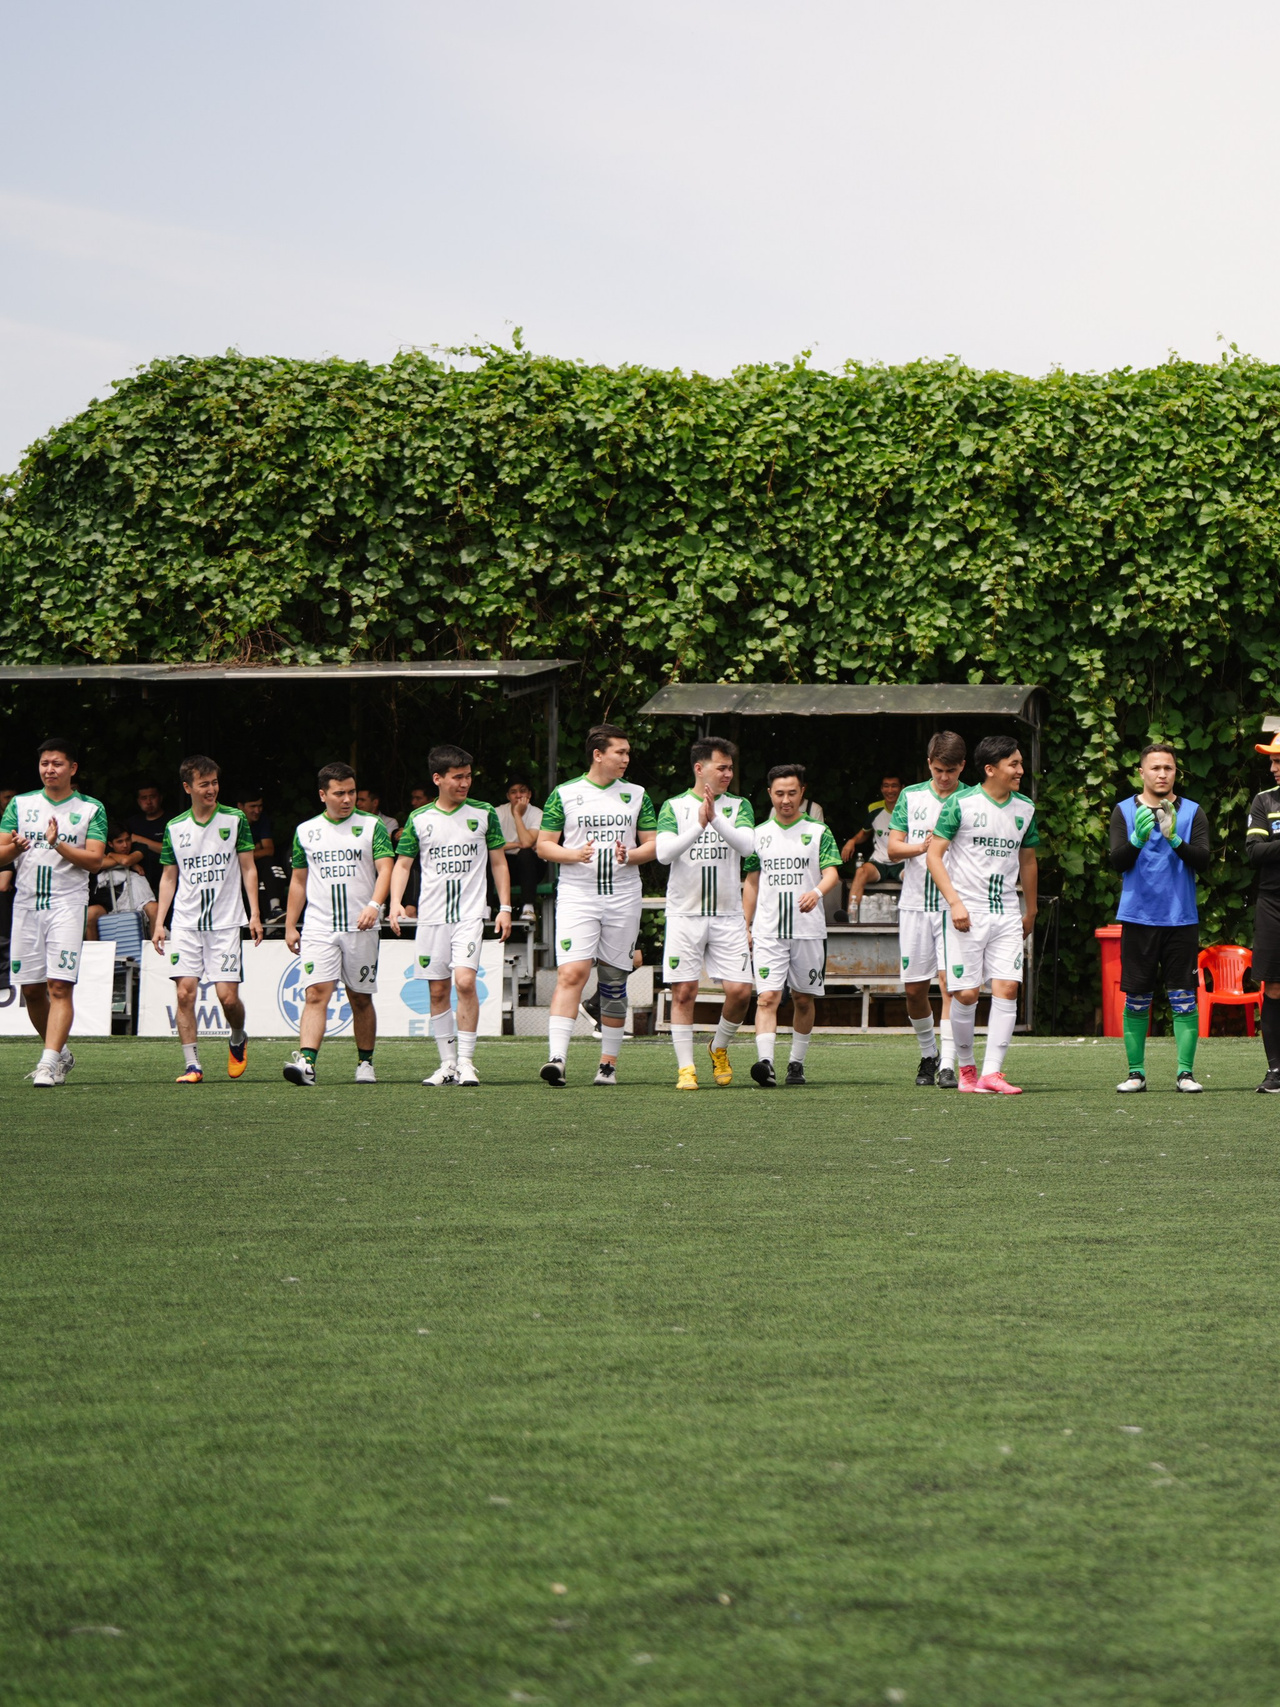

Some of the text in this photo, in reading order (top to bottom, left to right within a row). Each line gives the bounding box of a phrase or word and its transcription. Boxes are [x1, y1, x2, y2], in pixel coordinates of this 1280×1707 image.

[25, 809, 39, 822] 55
[577, 814, 632, 828] FREEDOM
[973, 812, 988, 828] 20
[308, 828, 322, 843] 93
[426, 823, 433, 837] 9
[586, 830, 626, 842] CREDIT
[179, 833, 191, 848] 22
[760, 835, 772, 850] 99
[312, 848, 362, 864] FREEDOM
[429, 843, 478, 860] FREEDOM
[690, 847, 728, 860] CREDIT
[985, 849, 1011, 858] CREDIT
[183, 852, 231, 870] FREEDOM
[436, 860, 472, 874] CREDIT
[763, 857, 810, 871] FREEDOM
[190, 869, 226, 885] CREDIT
[320, 865, 356, 879] CREDIT
[768, 873, 804, 886] CREDIT
[466, 942, 476, 958] 9
[58, 950, 77, 970] 55
[221, 954, 238, 972] 22
[741, 953, 748, 971] 7
[358, 965, 377, 983] 93
